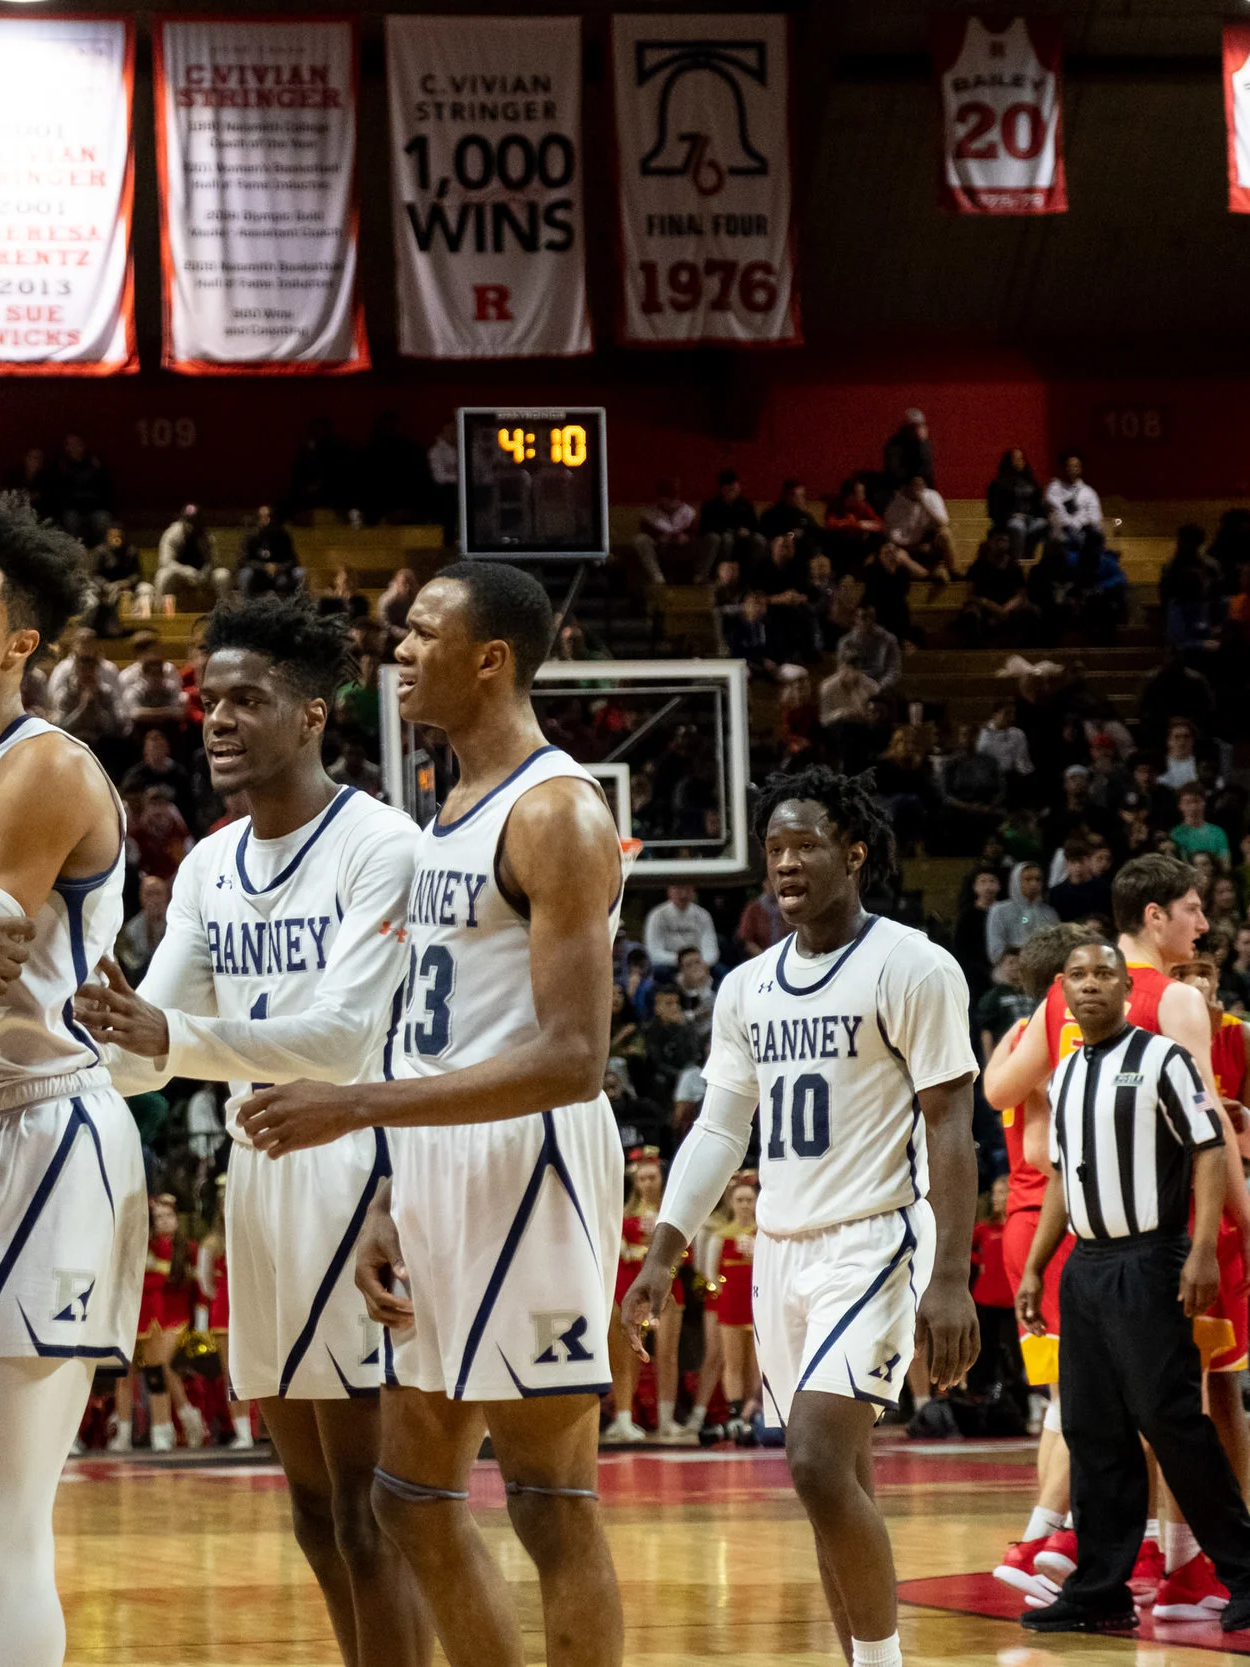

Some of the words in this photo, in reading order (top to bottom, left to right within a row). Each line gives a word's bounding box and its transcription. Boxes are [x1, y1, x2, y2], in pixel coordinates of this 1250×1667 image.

[212, 64, 330, 85] VIVIAN
[450, 74, 550, 95] VIVIAN
[953, 74, 1045, 93] BAILEY
[176, 87, 342, 108] STRINGER
[415, 102, 557, 121] STRINGER
[954, 102, 1046, 159] 20
[404, 133, 575, 198] 1,000
[406, 201, 575, 253] WINS
[713, 214, 768, 236] FOUR
[472, 284, 513, 321] R
[639, 259, 780, 314] 1976
[4, 305, 64, 323] SUE
[134, 417, 197, 448] 109
[497, 424, 587, 467] 4:10
[767, 1073, 831, 1160] 10
[529, 1310, 594, 1365] R
